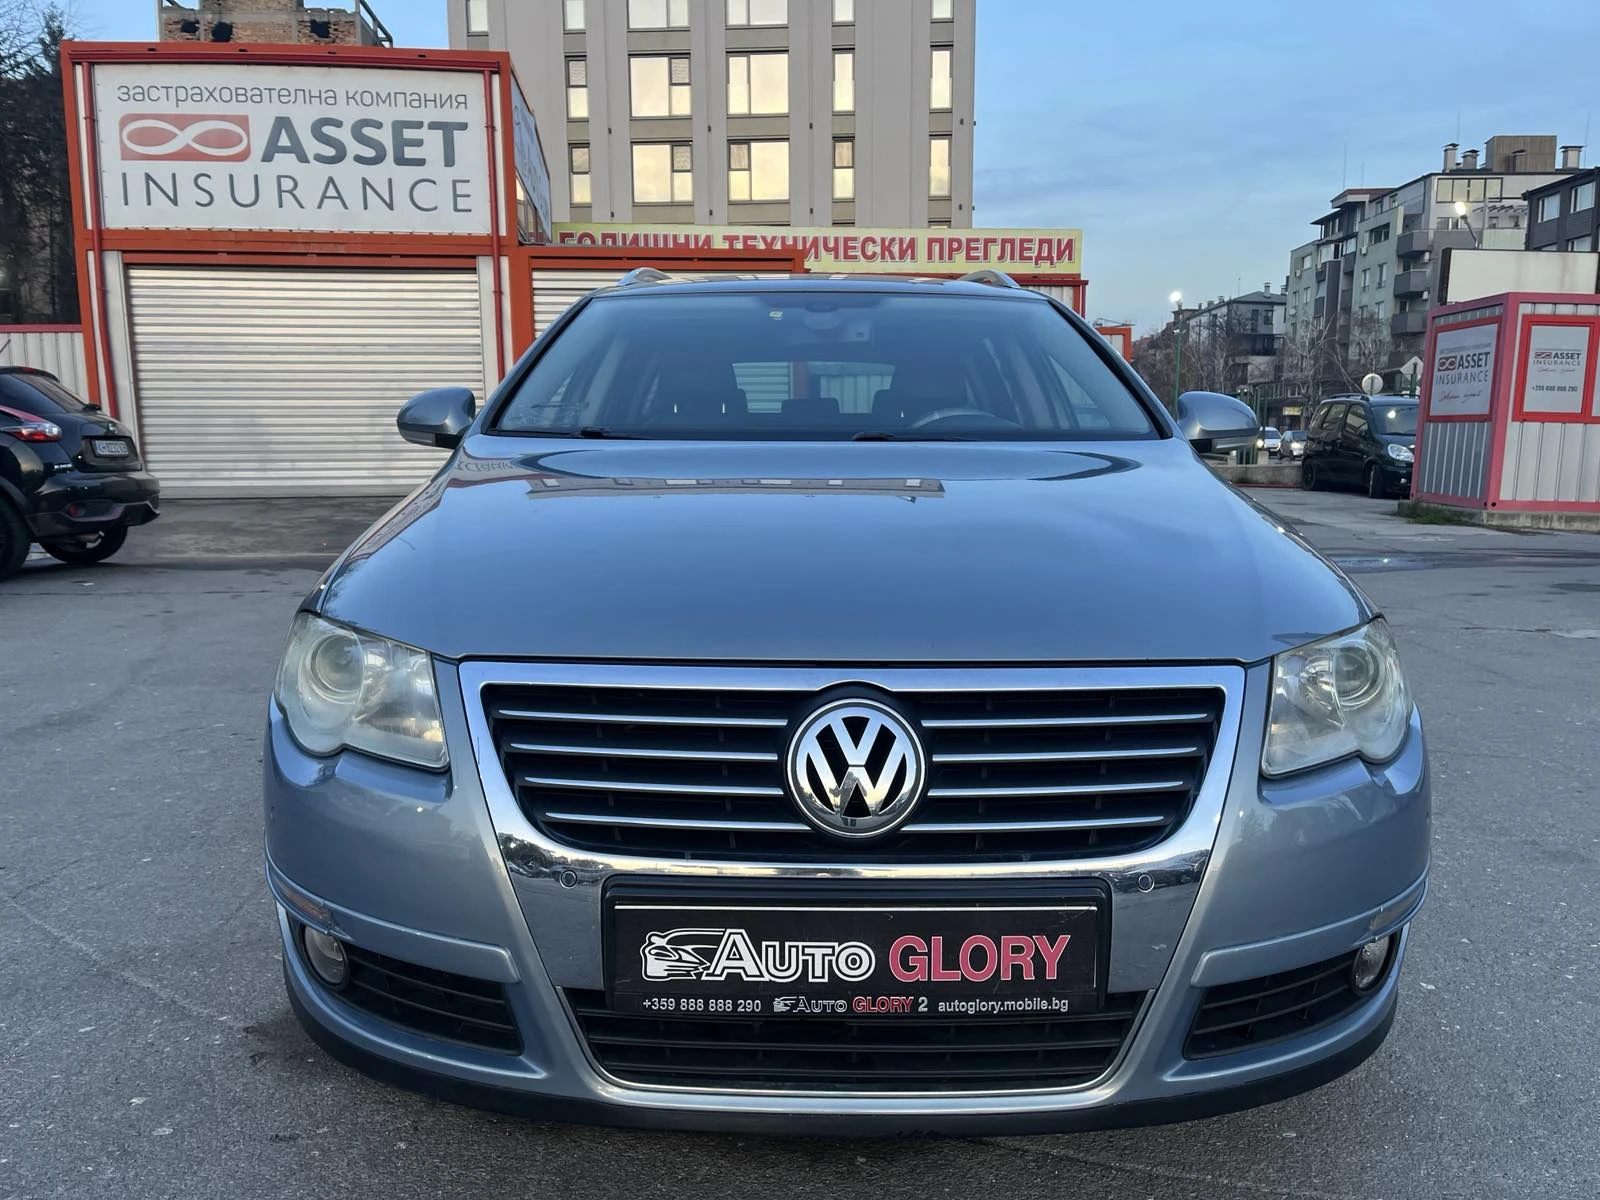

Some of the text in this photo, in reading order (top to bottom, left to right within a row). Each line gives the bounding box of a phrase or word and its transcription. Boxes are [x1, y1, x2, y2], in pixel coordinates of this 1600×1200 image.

[117, 85, 468, 110] застрахователна компания
[261, 116, 469, 168] ASSET
[121, 172, 472, 213] INSURANCE
[926, 237, 1076, 268] ПРЕГЛЕДИ
[1457, 351, 1491, 370] ASSET
[1552, 352, 1582, 360] ASSET
[1435, 369, 1489, 385] INSURANCE
[788, 698, 925, 838] VW
[888, 934, 1072, 983] GLORY
[643, 998, 676, 1011] +359
[680, 998, 704, 1011] 888
[708, 999, 733, 1012] 888
[737, 999, 762, 1012] 290
[852, 996, 914, 1013] GLORY
[917, 996, 928, 1012] 2
[937, 997, 1070, 1015] autoglory.mobile.bg
